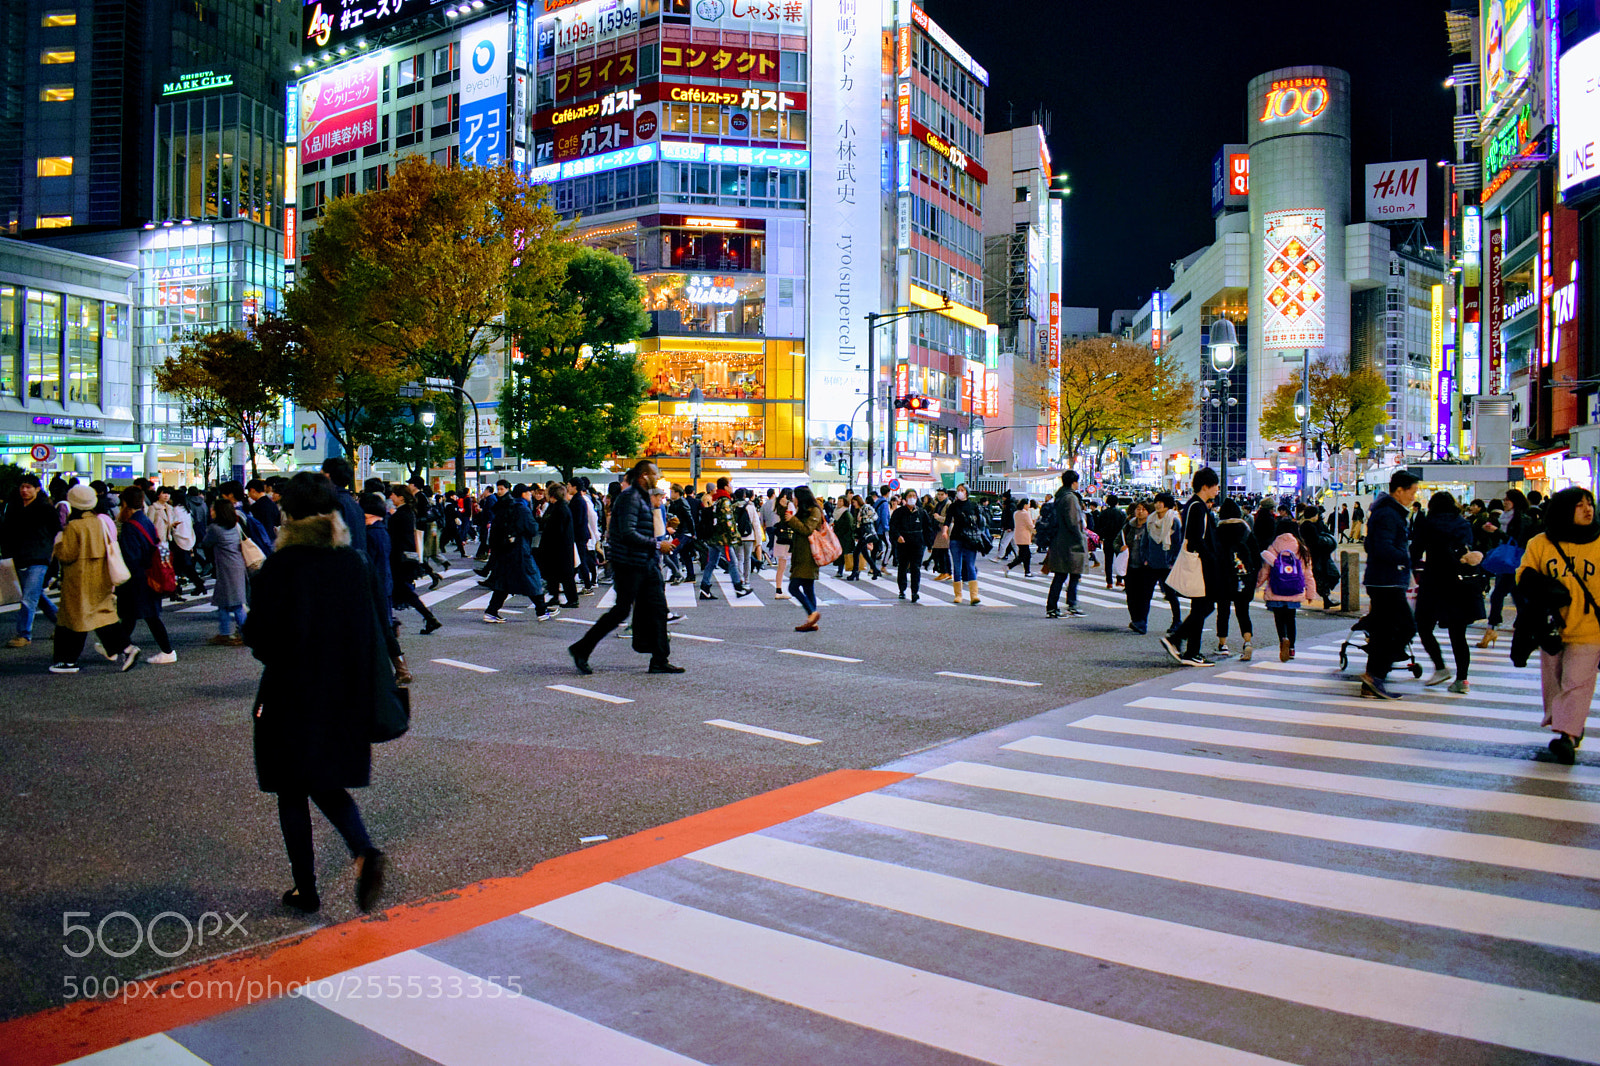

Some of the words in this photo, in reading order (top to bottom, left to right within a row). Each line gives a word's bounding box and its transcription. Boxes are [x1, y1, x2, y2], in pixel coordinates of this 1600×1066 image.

[732, 0, 803, 23] しゃぶ葉
[539, 30, 554, 46] 9F
[662, 47, 776, 74] コンタクト
[163, 80, 199, 93] MARK
[201, 74, 232, 86] CITY
[180, 70, 215, 82] SHIBUYA
[465, 74, 500, 95] eyecity
[557, 54, 635, 94] プライス
[1271, 77, 1328, 91] SHIBUYA
[601, 88, 642, 117] ガスト
[741, 88, 795, 112] ガスト
[311, 119, 374, 154] 品川美容外科
[558, 134, 579, 150] Café
[580, 123, 629, 156] ガスト
[536, 141, 554, 160] 7F
[836, 119, 857, 205] 小林武史
[1565, 140, 1595, 180] LINE
[1234, 159, 1249, 174] U
[1234, 175, 1249, 193] Q
[1373, 166, 1420, 200] H&M
[1491, 255, 1501, 358] ウィンターフルーツギフト
[1503, 290, 1534, 321] Euphoria
